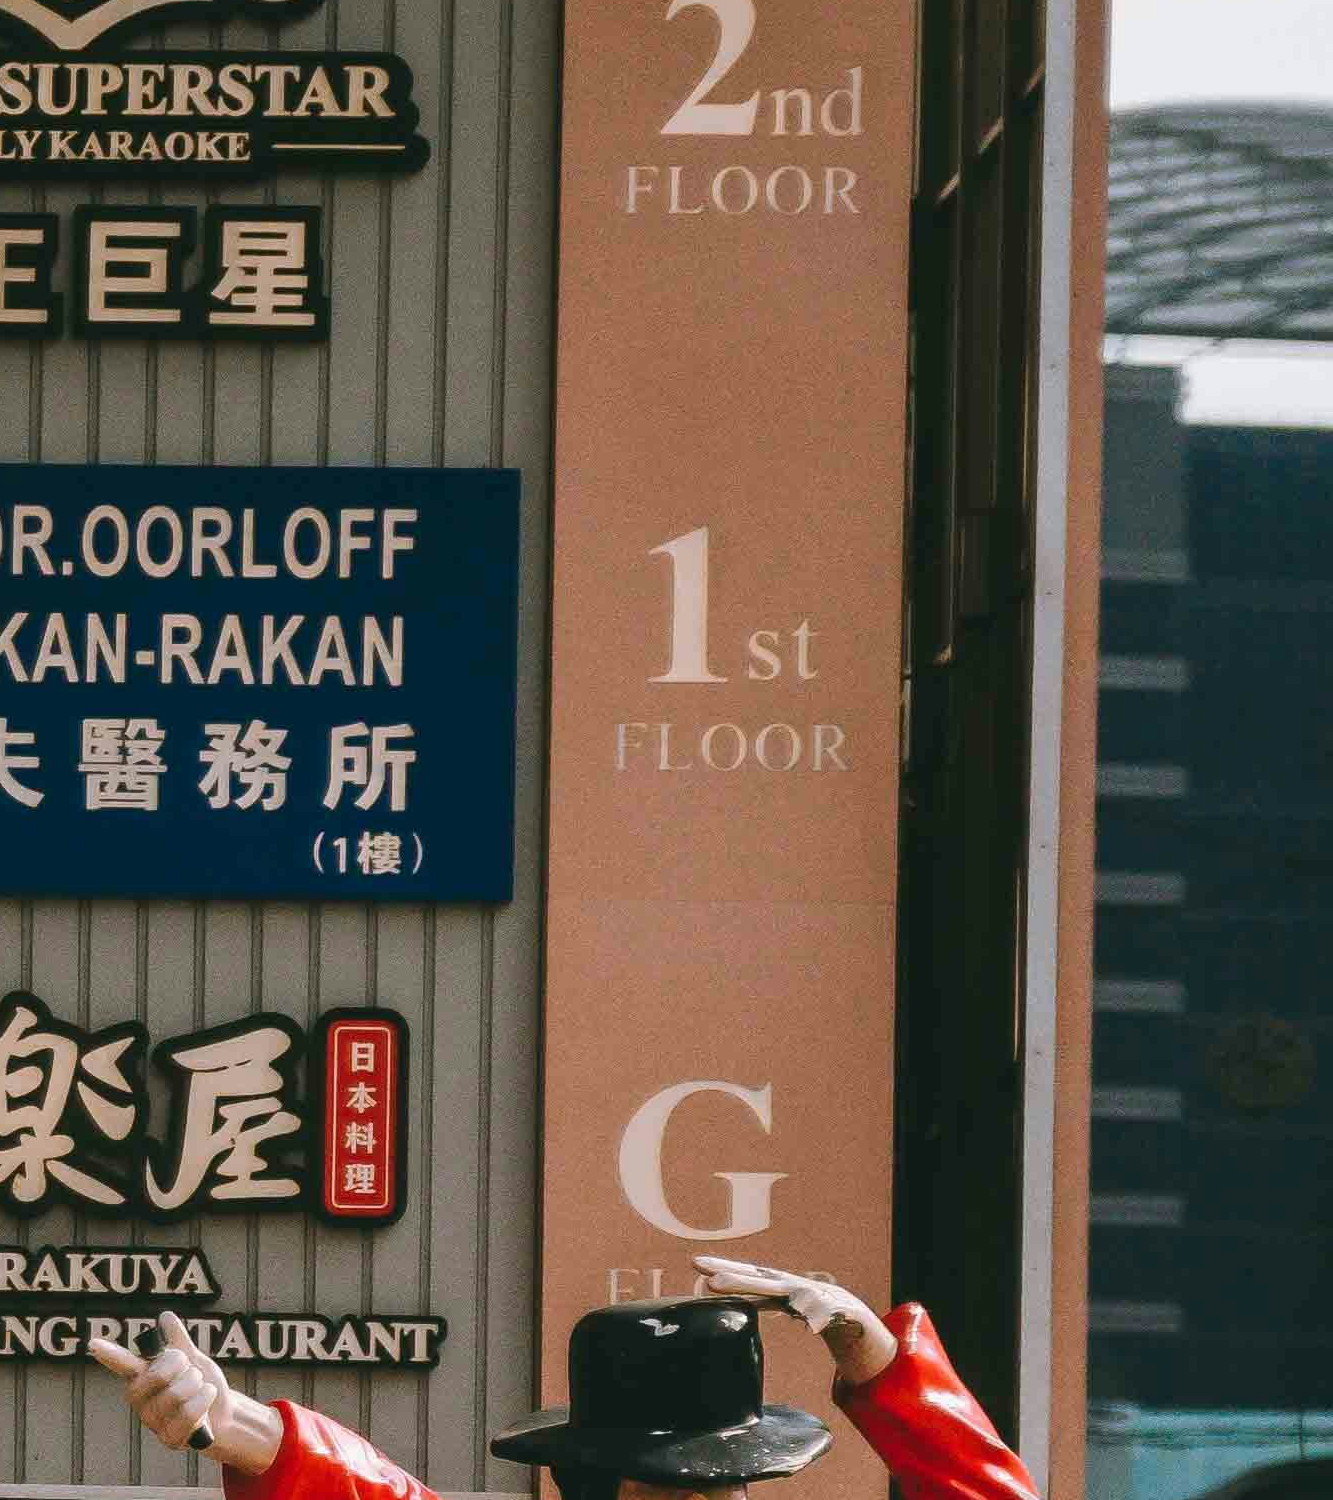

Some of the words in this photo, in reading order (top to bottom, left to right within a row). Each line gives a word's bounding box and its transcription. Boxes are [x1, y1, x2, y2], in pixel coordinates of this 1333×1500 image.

[47, 130, 251, 163] KARAOKE
[622, 165, 862, 215] FLOOR
[647, 525, 821, 685] 1st
[613, 722, 850, 773] FLOOR
[344, 1041, 377, 1197] 日本料理
[618, 1080, 790, 1242] G
[86, 1317, 439, 1362] RETAURANT
